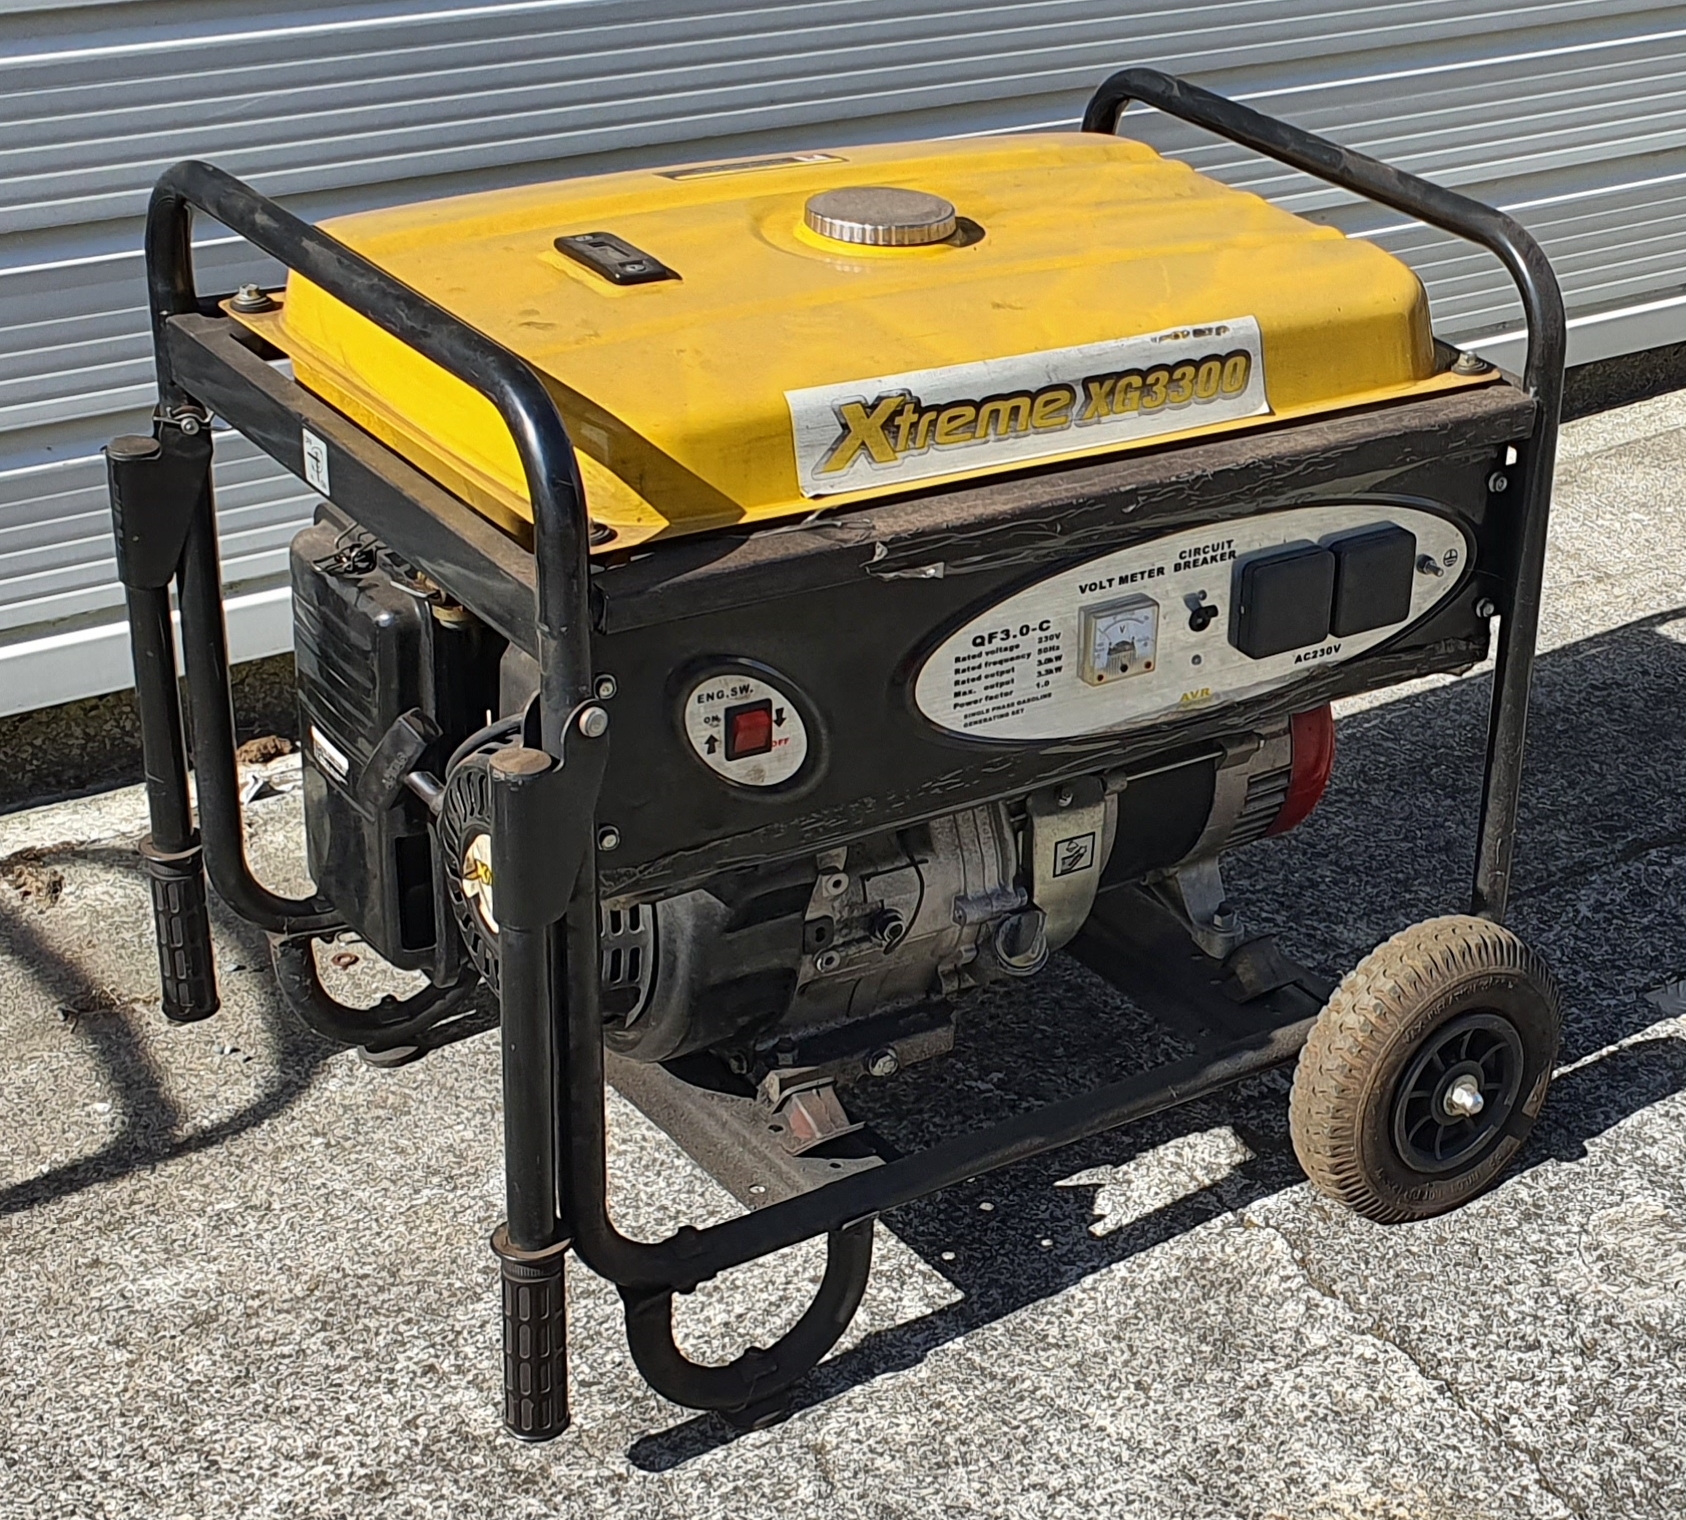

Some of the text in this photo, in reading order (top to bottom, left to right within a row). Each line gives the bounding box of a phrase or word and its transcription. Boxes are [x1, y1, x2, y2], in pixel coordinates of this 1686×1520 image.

[817, 354, 1248, 476] Xtreme XG3300
[1173, 549, 1237, 573] BREAKER
[1178, 539, 1235, 561] CIRCUIT
[1078, 566, 1166, 594] VOLT METER
[971, 619, 1051, 648] QF3.0-C
[954, 631, 1062, 664] Rated voltage 230V
[1294, 643, 1342, 664] AC230V
[953, 662, 983, 675] Rated
[984, 651, 1032, 669] frequency
[953, 674, 982, 687] Rated
[983, 666, 1015, 680] output
[696, 683, 754, 704] ENG.SW.
[953, 688, 977, 699] Max.
[983, 677, 1015, 691] output
[953, 679, 1050, 711] Power factor 1.0
[1179, 687, 1211, 703] AVR
[963, 692, 1053, 720] SINGLE PHASE GASOLINE
[703, 714, 721, 724] ON
[963, 707, 1025, 728] GENERATING SET
[771, 737, 790, 748] OFF
